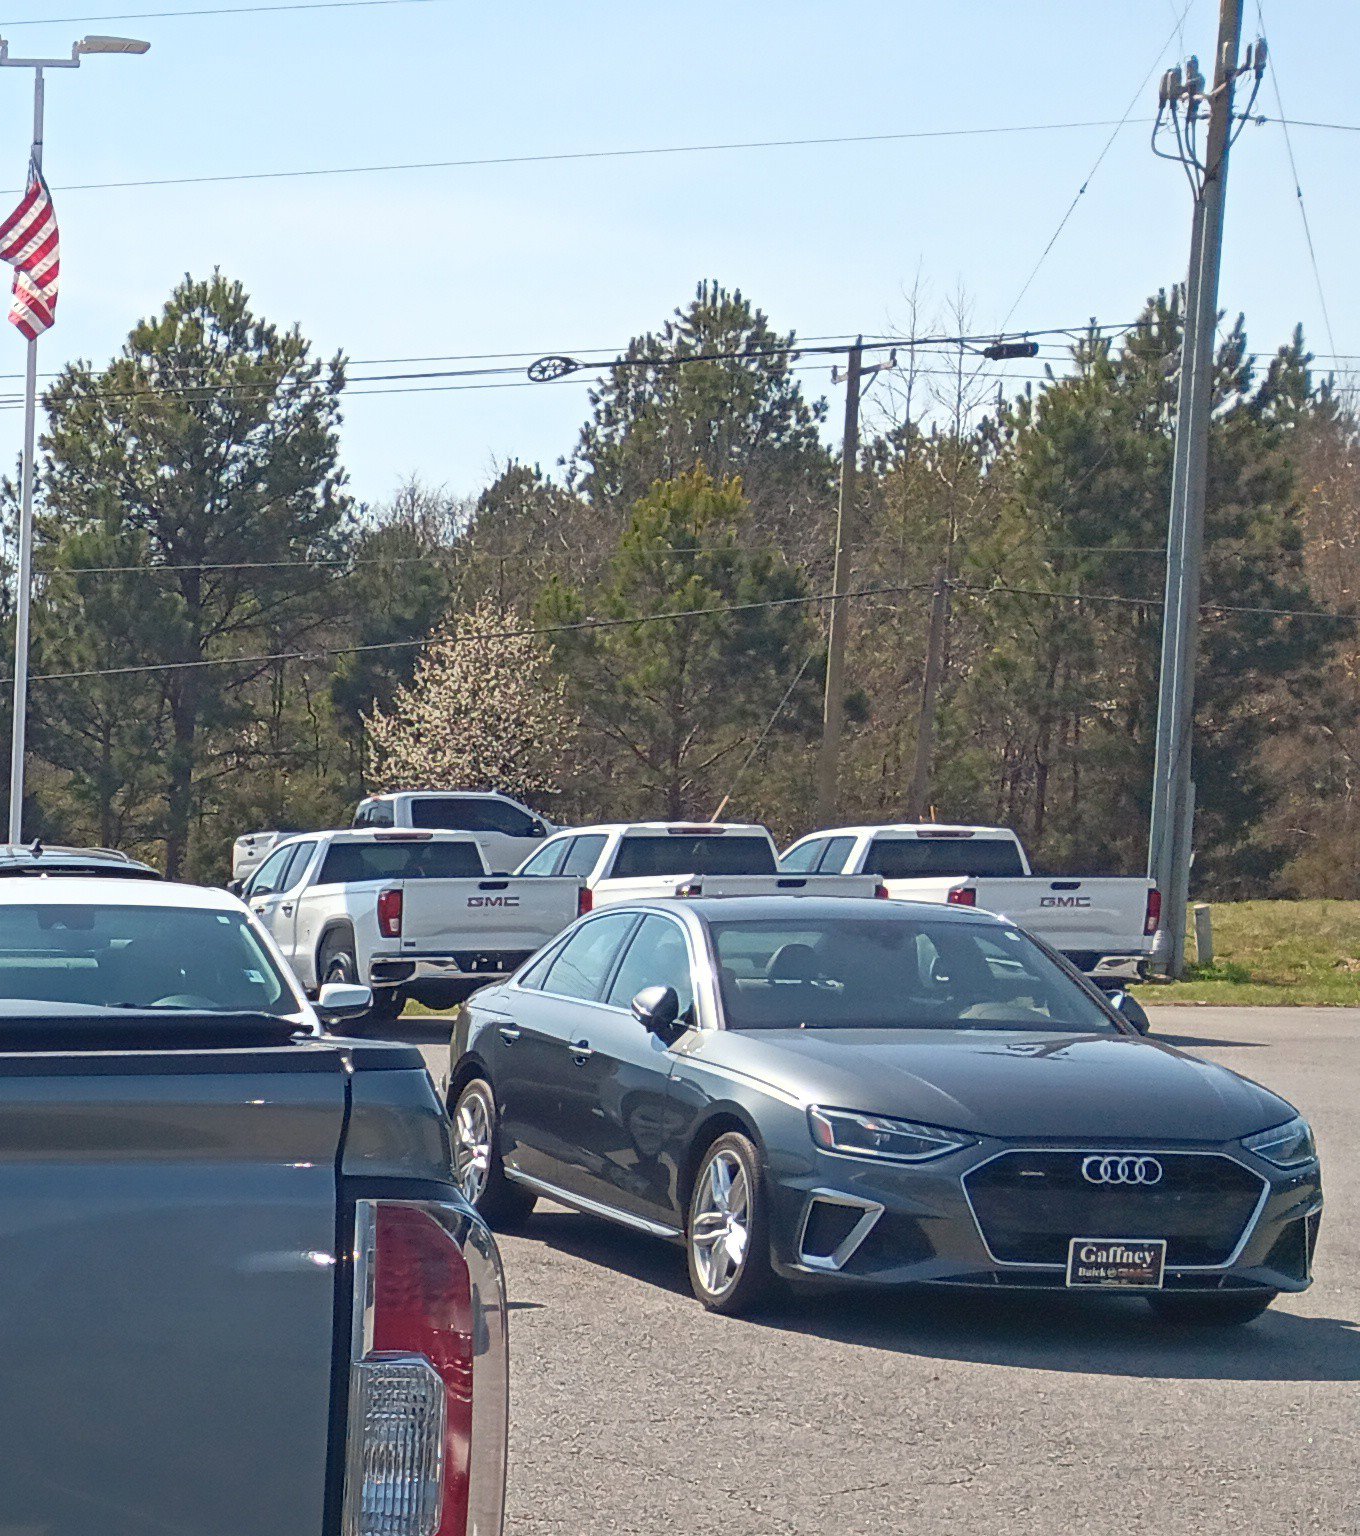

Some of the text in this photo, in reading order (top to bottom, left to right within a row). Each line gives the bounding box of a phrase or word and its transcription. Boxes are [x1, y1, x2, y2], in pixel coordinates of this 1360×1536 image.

[467, 896, 519, 907] GMC
[1040, 896, 1090, 907] GMC
[1080, 1245, 1155, 1268] Gaffney
